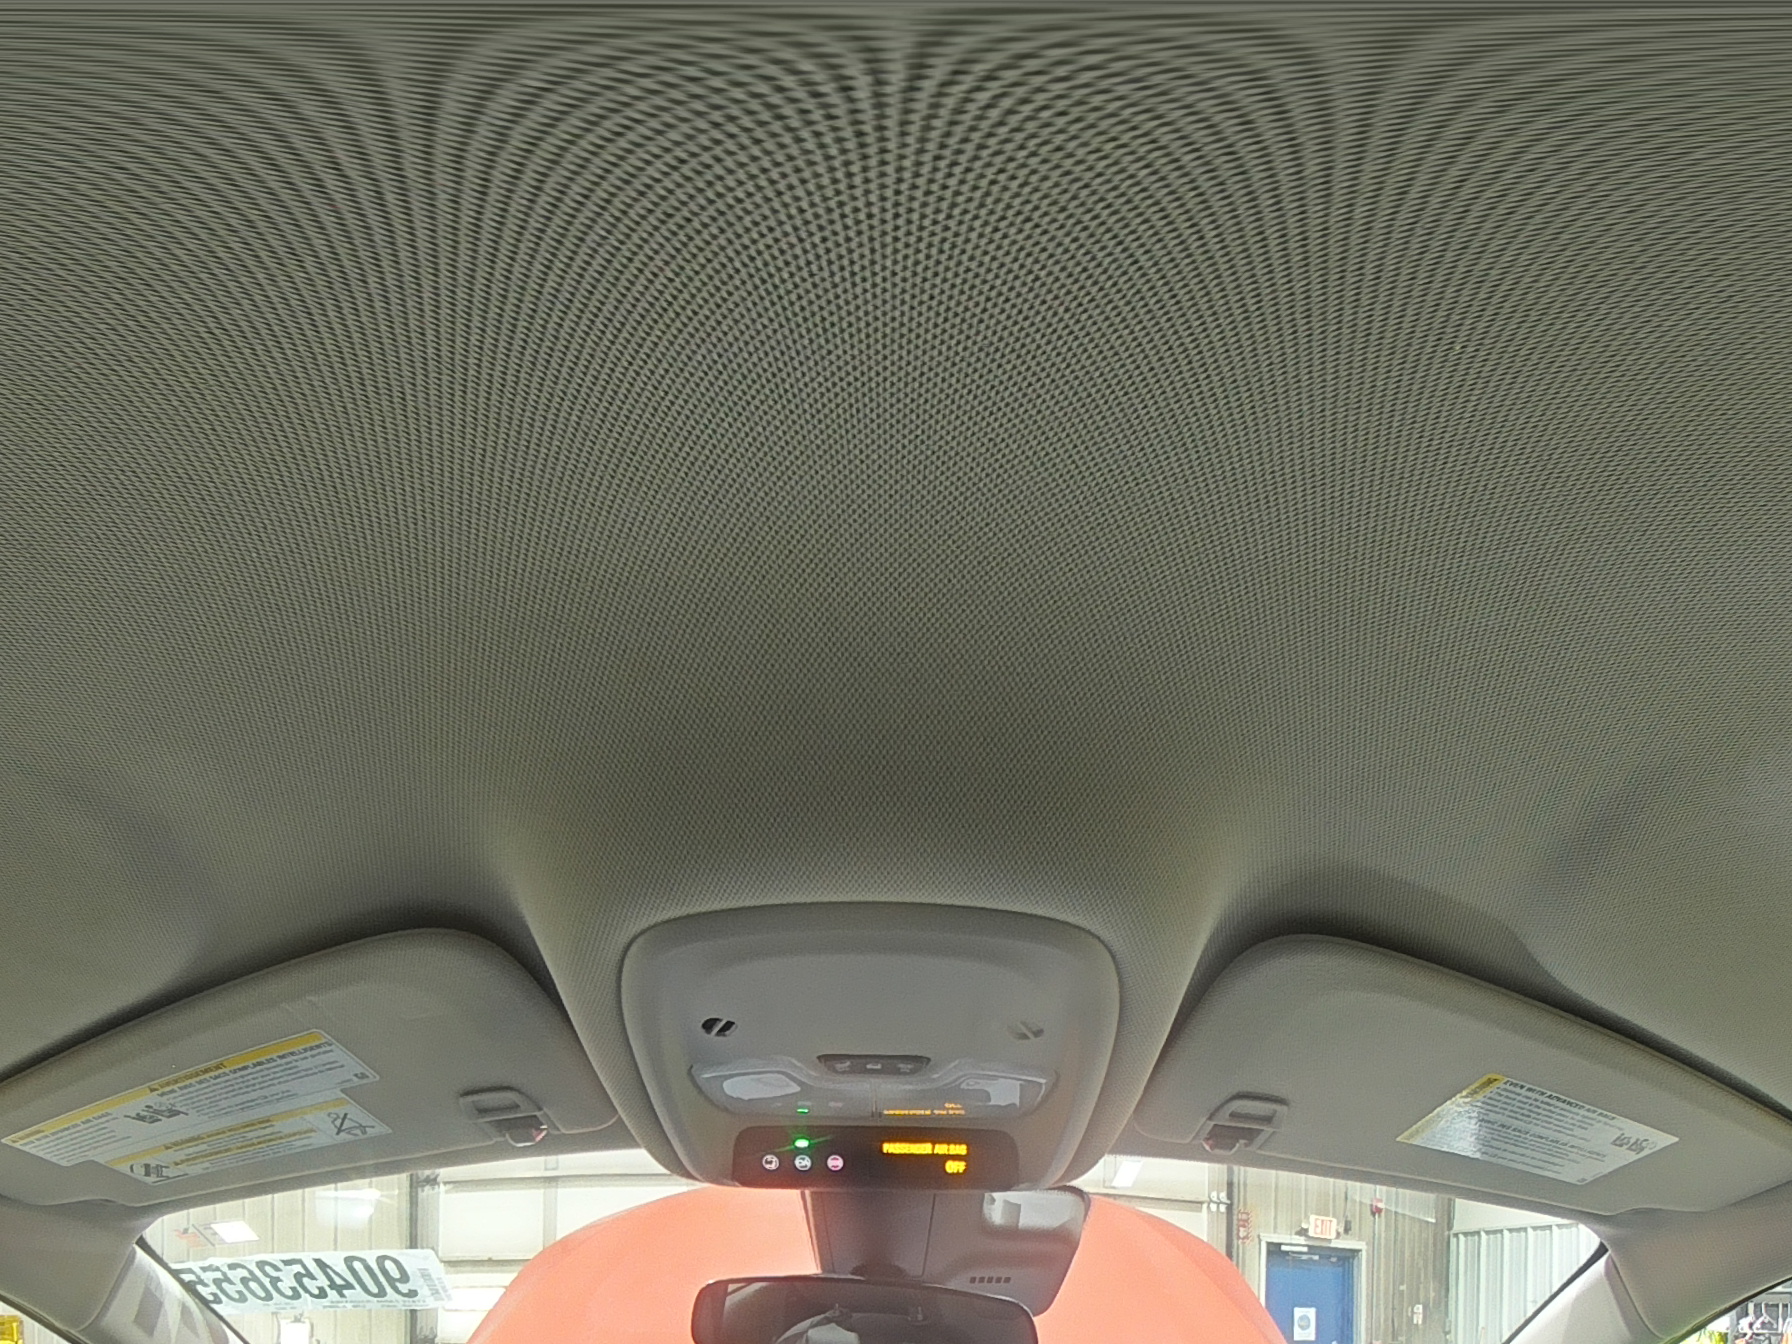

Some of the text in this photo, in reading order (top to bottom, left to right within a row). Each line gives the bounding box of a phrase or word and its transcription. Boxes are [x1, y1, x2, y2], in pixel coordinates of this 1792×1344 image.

[882, 1142, 968, 1155] PASSENGER AIR BAG
[945, 1160, 966, 1173] OFF
[1313, 1217, 1334, 1236] EXIT
